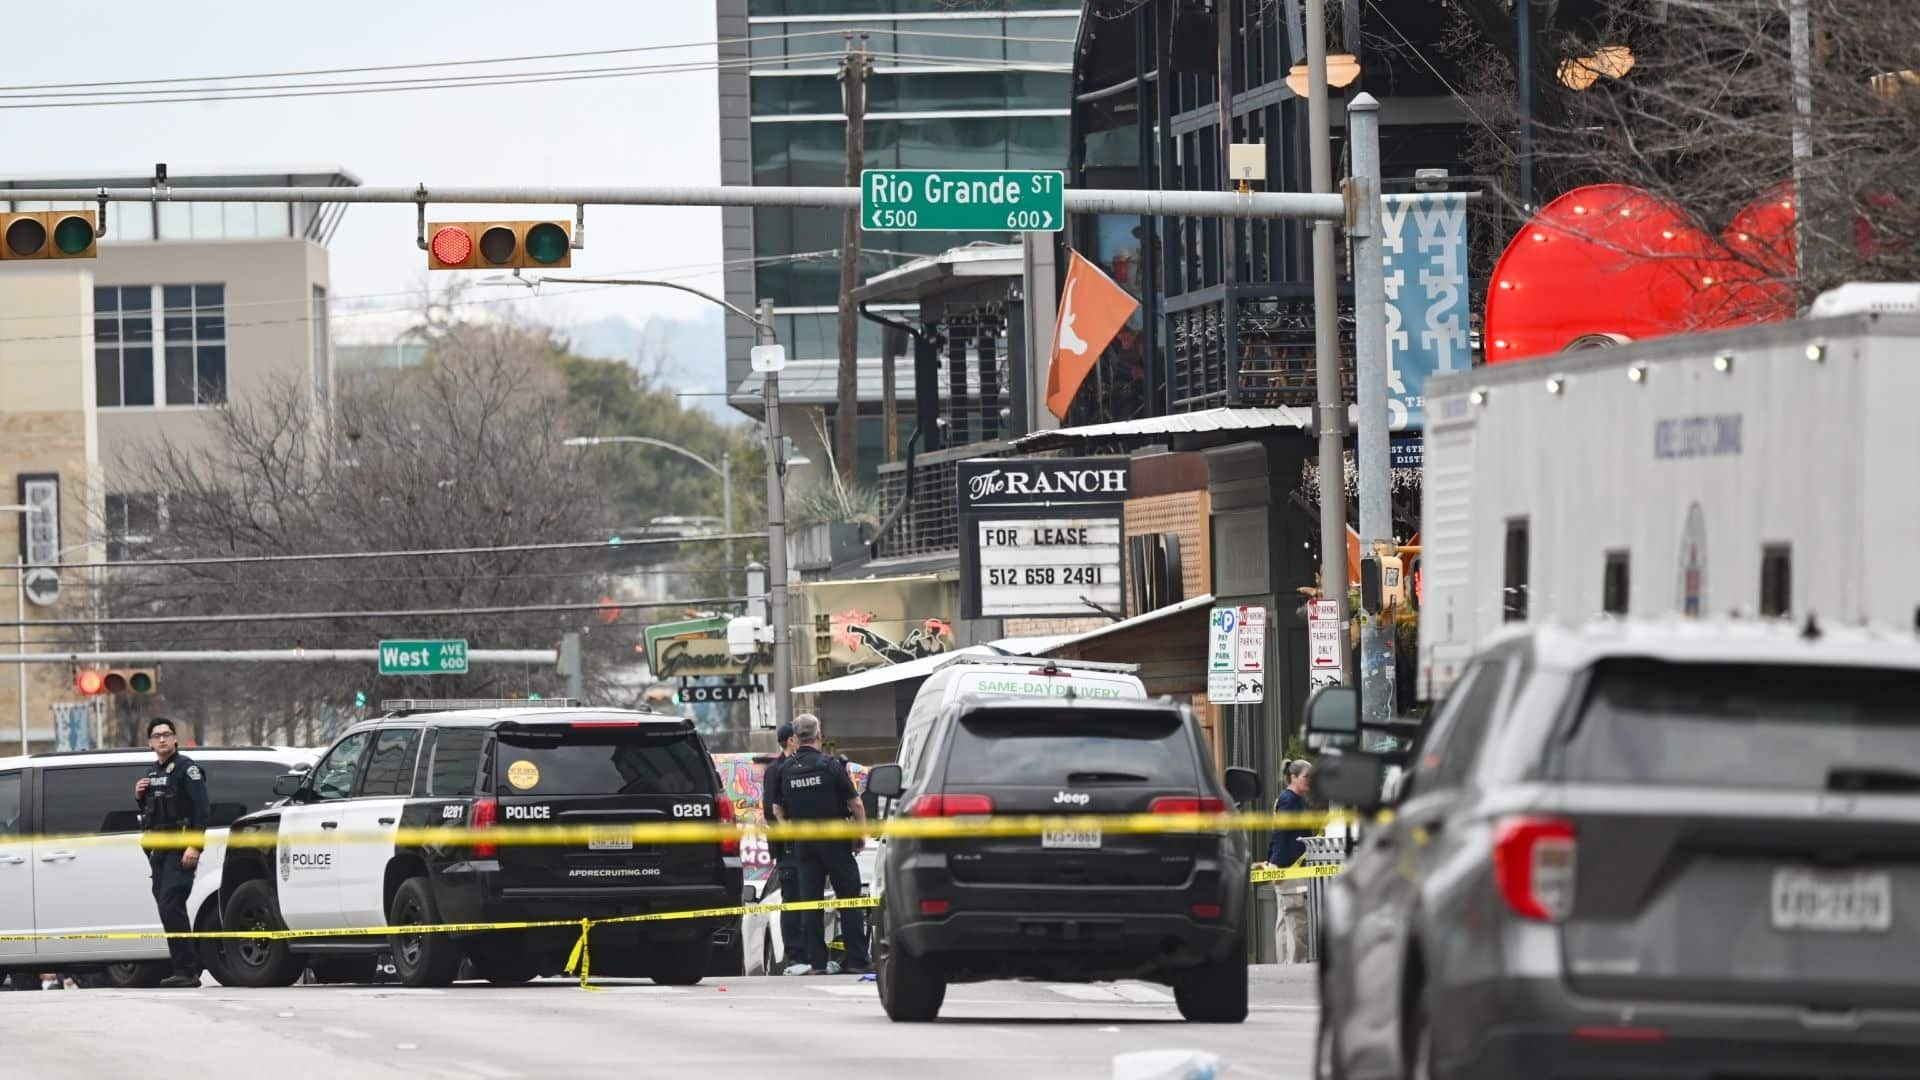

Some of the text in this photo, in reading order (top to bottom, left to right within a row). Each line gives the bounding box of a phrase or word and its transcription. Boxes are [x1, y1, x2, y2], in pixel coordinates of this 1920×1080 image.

[871, 173, 1053, 204] Rio Grande ST
[884, 210, 918, 227] 500
[1007, 211, 1040, 228] 600
[968, 469, 1128, 500] The RANCH
[986, 528, 1088, 546] FOR LEASE
[990, 567, 1102, 586] 512 658 2491
[383, 643, 464, 667] West AVE
[440, 657, 465, 669] 600
[681, 687, 758, 701] SOCIA
[977, 680, 1054, 695] SAME-DAY
[790, 776, 822, 789] POLICE
[1053, 791, 1090, 805] Jeep
[442, 805, 464, 819] 0281
[506, 805, 551, 820] POLICE
[672, 803, 712, 818] 0281
[292, 853, 332, 866] POLICE
[568, 867, 661, 878] APDRECRUITING.ORG
[1262, 870, 1287, 880] CROSS
[1315, 865, 1338, 876] POLIC
